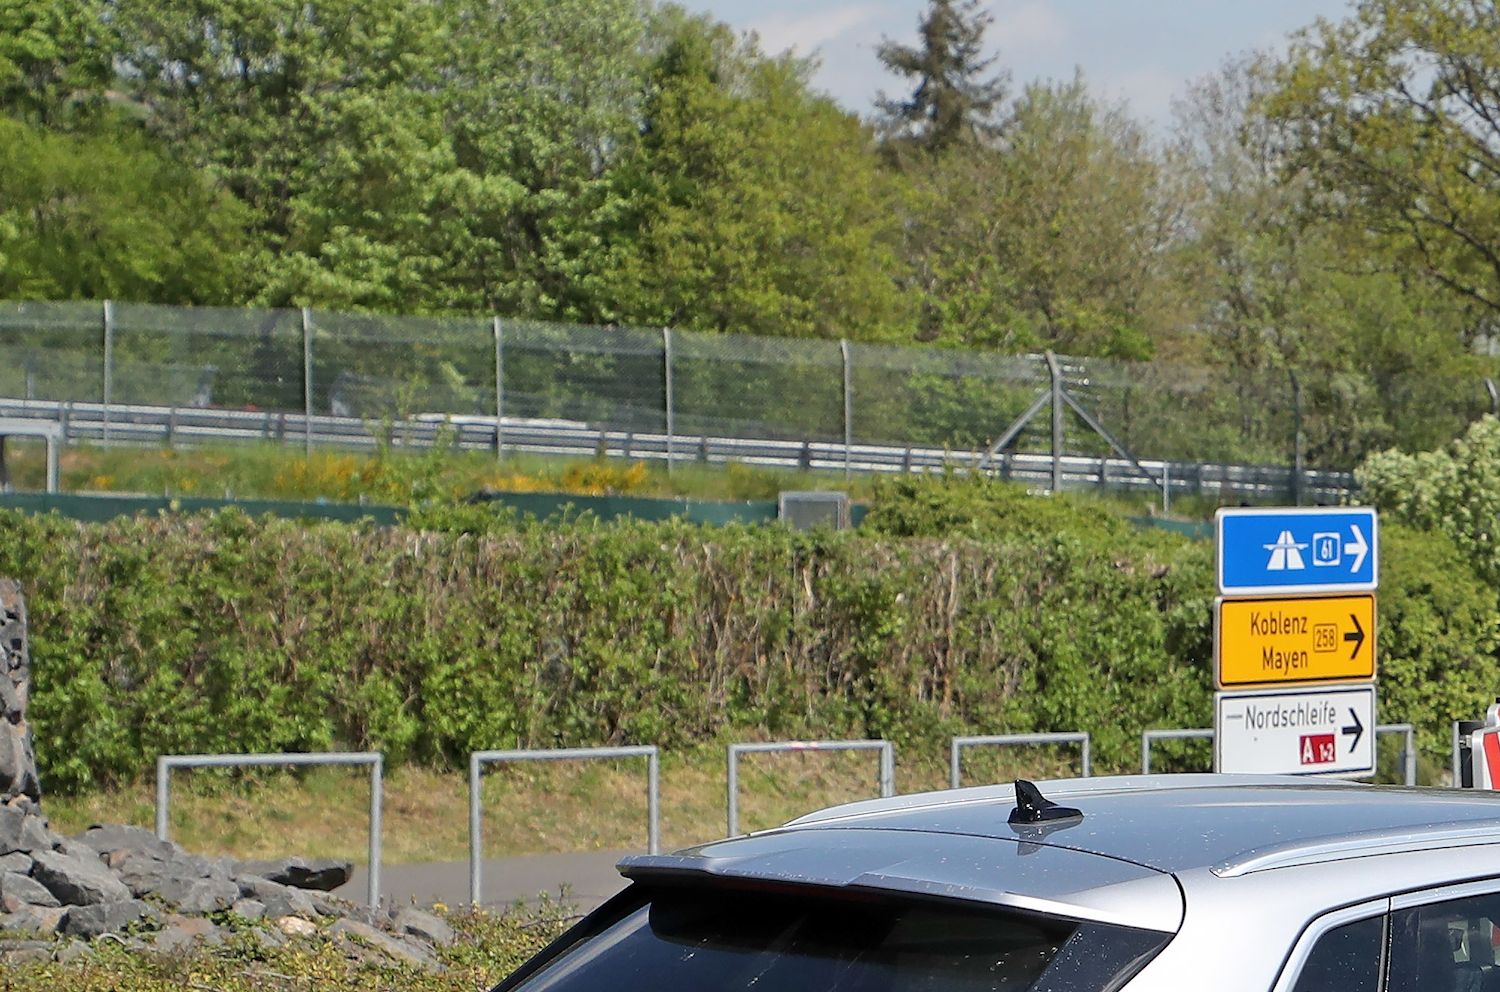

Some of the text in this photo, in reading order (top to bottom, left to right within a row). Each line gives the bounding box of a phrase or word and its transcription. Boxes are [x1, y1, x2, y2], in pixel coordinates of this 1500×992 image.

[1321, 539, 1333, 559] 61
[1250, 611, 1308, 636] Koblenz
[1316, 628, 1335, 648] 258
[1262, 646, 1308, 676] Mayen
[1245, 701, 1336, 730] Nordschleife
[1302, 736, 1315, 763] A
